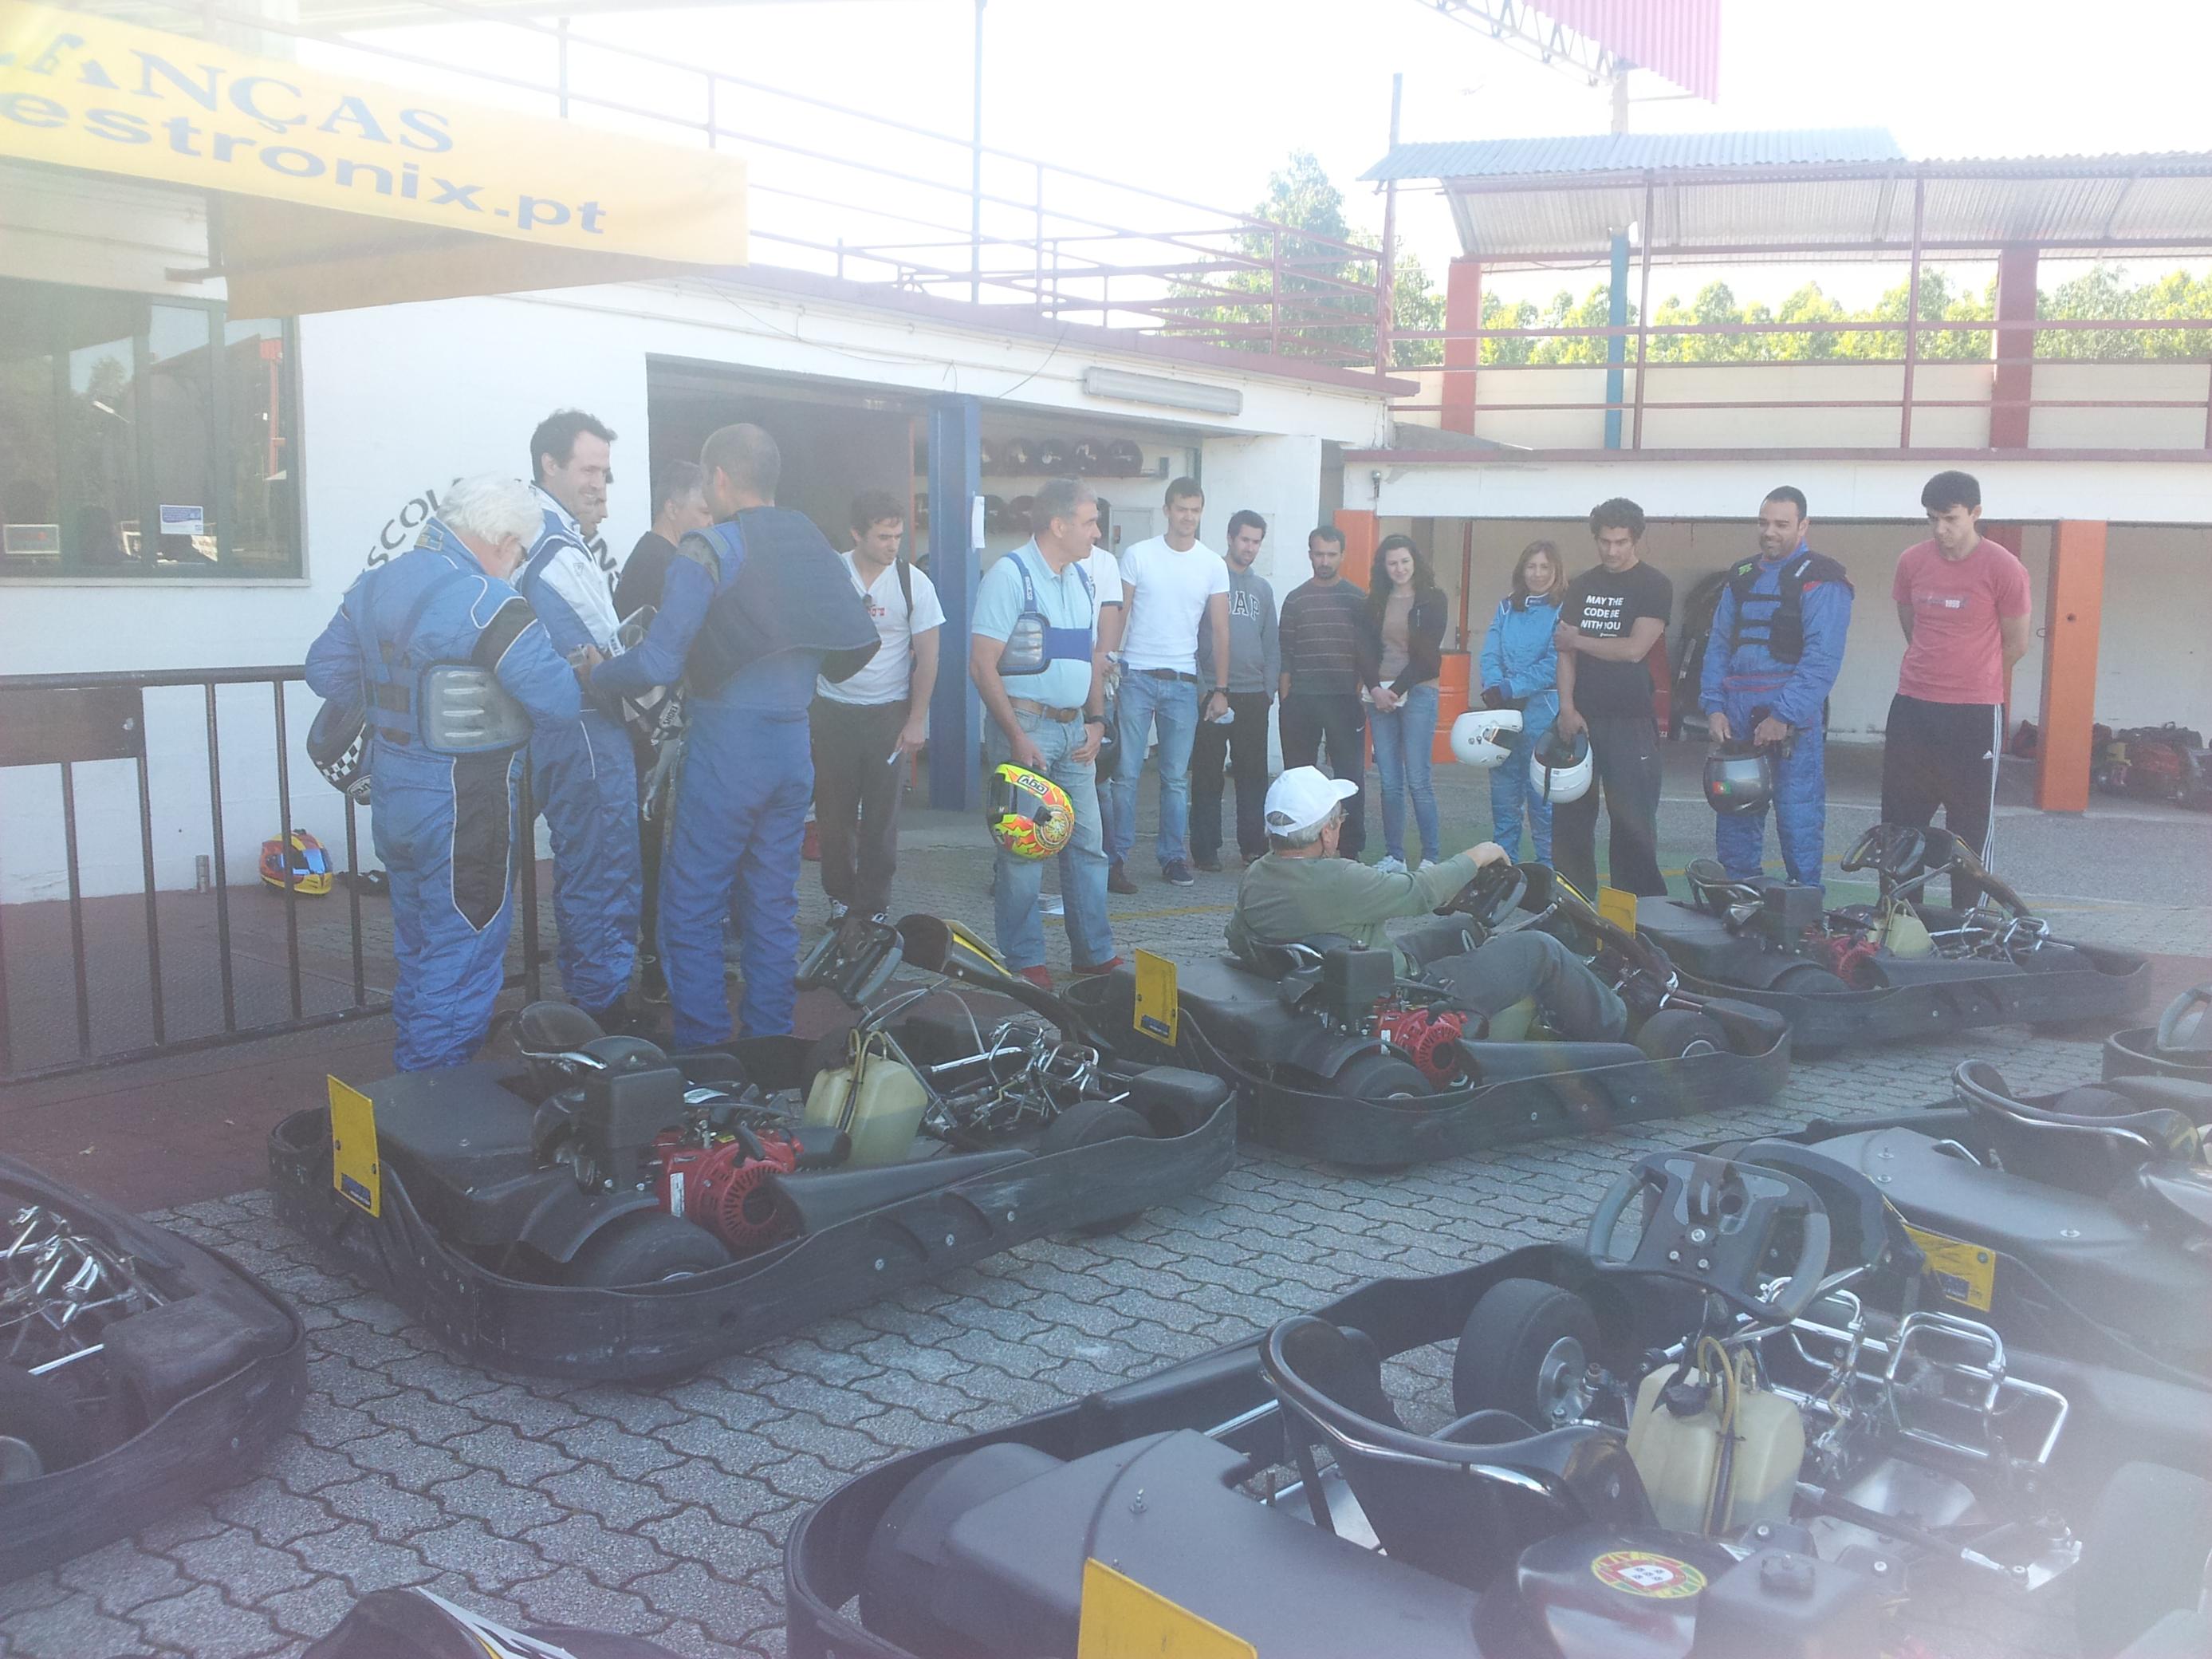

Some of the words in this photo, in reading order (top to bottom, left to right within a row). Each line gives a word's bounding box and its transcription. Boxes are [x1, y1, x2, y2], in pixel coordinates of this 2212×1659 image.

[0, 33, 453, 153] ANÇAS
[363, 481, 455, 571] SCOL
[1227, 590, 1260, 621] AP
[1584, 607, 1610, 618] CODE
[1585, 595, 1607, 605] MAY
[1608, 597, 1624, 606] THE
